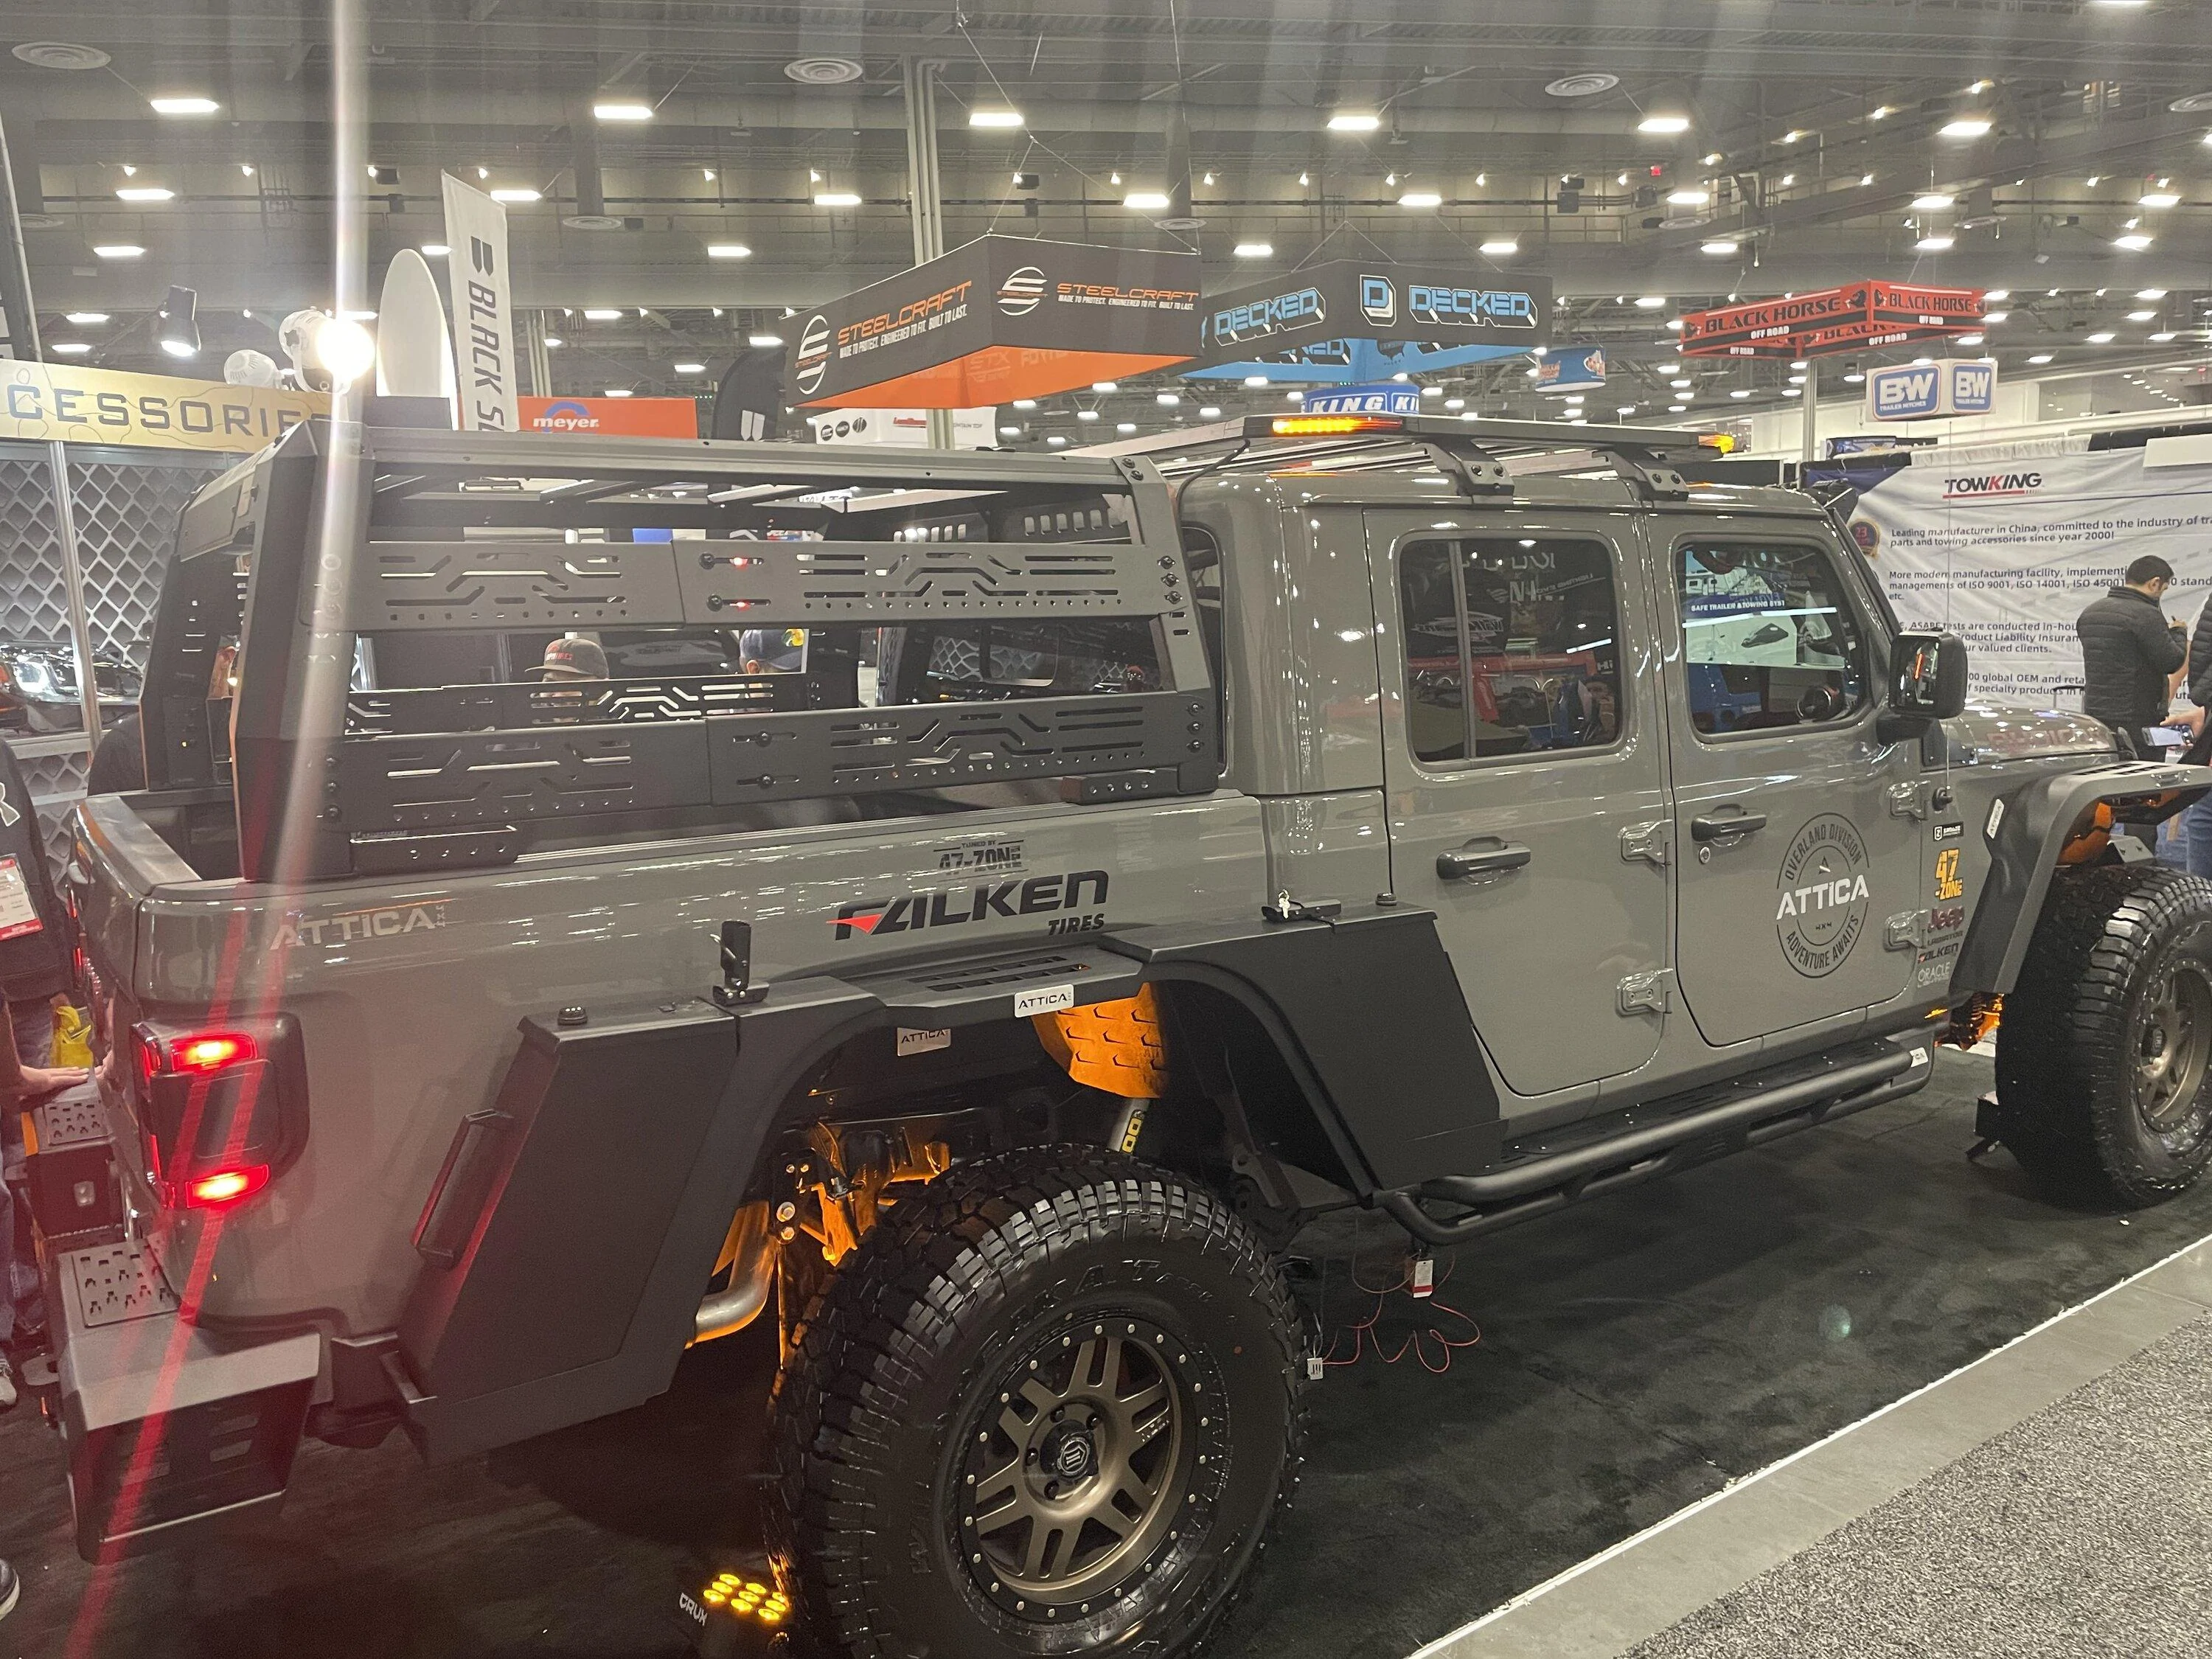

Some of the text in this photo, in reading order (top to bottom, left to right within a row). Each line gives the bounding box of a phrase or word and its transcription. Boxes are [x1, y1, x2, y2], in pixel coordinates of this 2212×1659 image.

[1057, 283, 1199, 302] STEELCRAFT
[1108, 298, 1139, 307] ENGINEERED
[1411, 287, 1534, 320] DECKED
[1889, 293, 1972, 312] BLACK HORSE
[838, 280, 972, 346] STEELCRAFT
[1215, 288, 1322, 339] DECKED
[1705, 296, 1840, 333] BLACK HORSE
[1919, 315, 1944, 324] OFF ROAD
[468, 280, 502, 394] BLACK
[1750, 326, 1790, 339] OFF ROAD
[1869, 333, 1907, 345] OFF ROAD
[7, 384, 330, 437] CESSORIE
[1312, 395, 1385, 413] KING
[1880, 400, 1926, 411] TRAILER HITCHES
[533, 416, 598, 431] meyer
[1945, 473, 2042, 493] TOWKING
[1892, 528, 1925, 538] Leading
[1928, 526, 1994, 536] manufacturer
[1997, 525, 2006, 533] in
[2008, 524, 2039, 533] China,
[2043, 520, 2099, 531] committed
[2103, 521, 2112, 529] to
[2117, 520, 2134, 529] the
[2138, 518, 2183, 528] industry
[2186, 515, 2199, 525] of
[1891, 538, 1913, 548] parts
[1916, 538, 1933, 546] and
[1935, 538, 1967, 547] towing
[1971, 535, 2027, 545] accessories
[2030, 534, 2055, 543] since
[2059, 533, 2081, 543] year
[1889, 571, 1911, 579] More
[1914, 571, 1950, 579] modern
[1954, 569, 2023, 579] manufacturing
[2026, 568, 2063, 577] facility,
[1889, 581, 1954, 591] managements
[1958, 580, 1966, 588] of
[1987, 581, 2013, 589] 9001,
[2017, 580, 2032, 588] ISO
[2037, 580, 2070, 589] 14001,
[2073, 580, 2090, 588] ISO
[1710, 602, 1736, 611] TRAILER
[1943, 622, 1965, 630] tests
[1987, 622, 2039, 630] conducted
[1958, 633, 1992, 641] roduct
[1995, 633, 2036, 643] Liability
[1978, 644, 2012, 653] valued
[2015, 644, 2052, 653] clients.
[1982, 673, 2013, 683] global
[2042, 675, 2062, 683] and
[1974, 684, 2017, 695] specialty
[1785, 824, 1862, 880] OVERLAND DIVISION
[1935, 848, 1961, 884] 47
[827, 870, 1109, 941] FALKEN
[1776, 874, 1869, 920] ATTICA
[270, 908, 436, 950] ATTICA
[1048, 913, 1105, 936] TIRES
[1787, 914, 1859, 970] ADVENTURE AWAITS
[1918, 943, 1959, 964] FALKEN
[1918, 961, 1950, 982] ORACLE
[1018, 993, 1067, 1009] ATTICA
